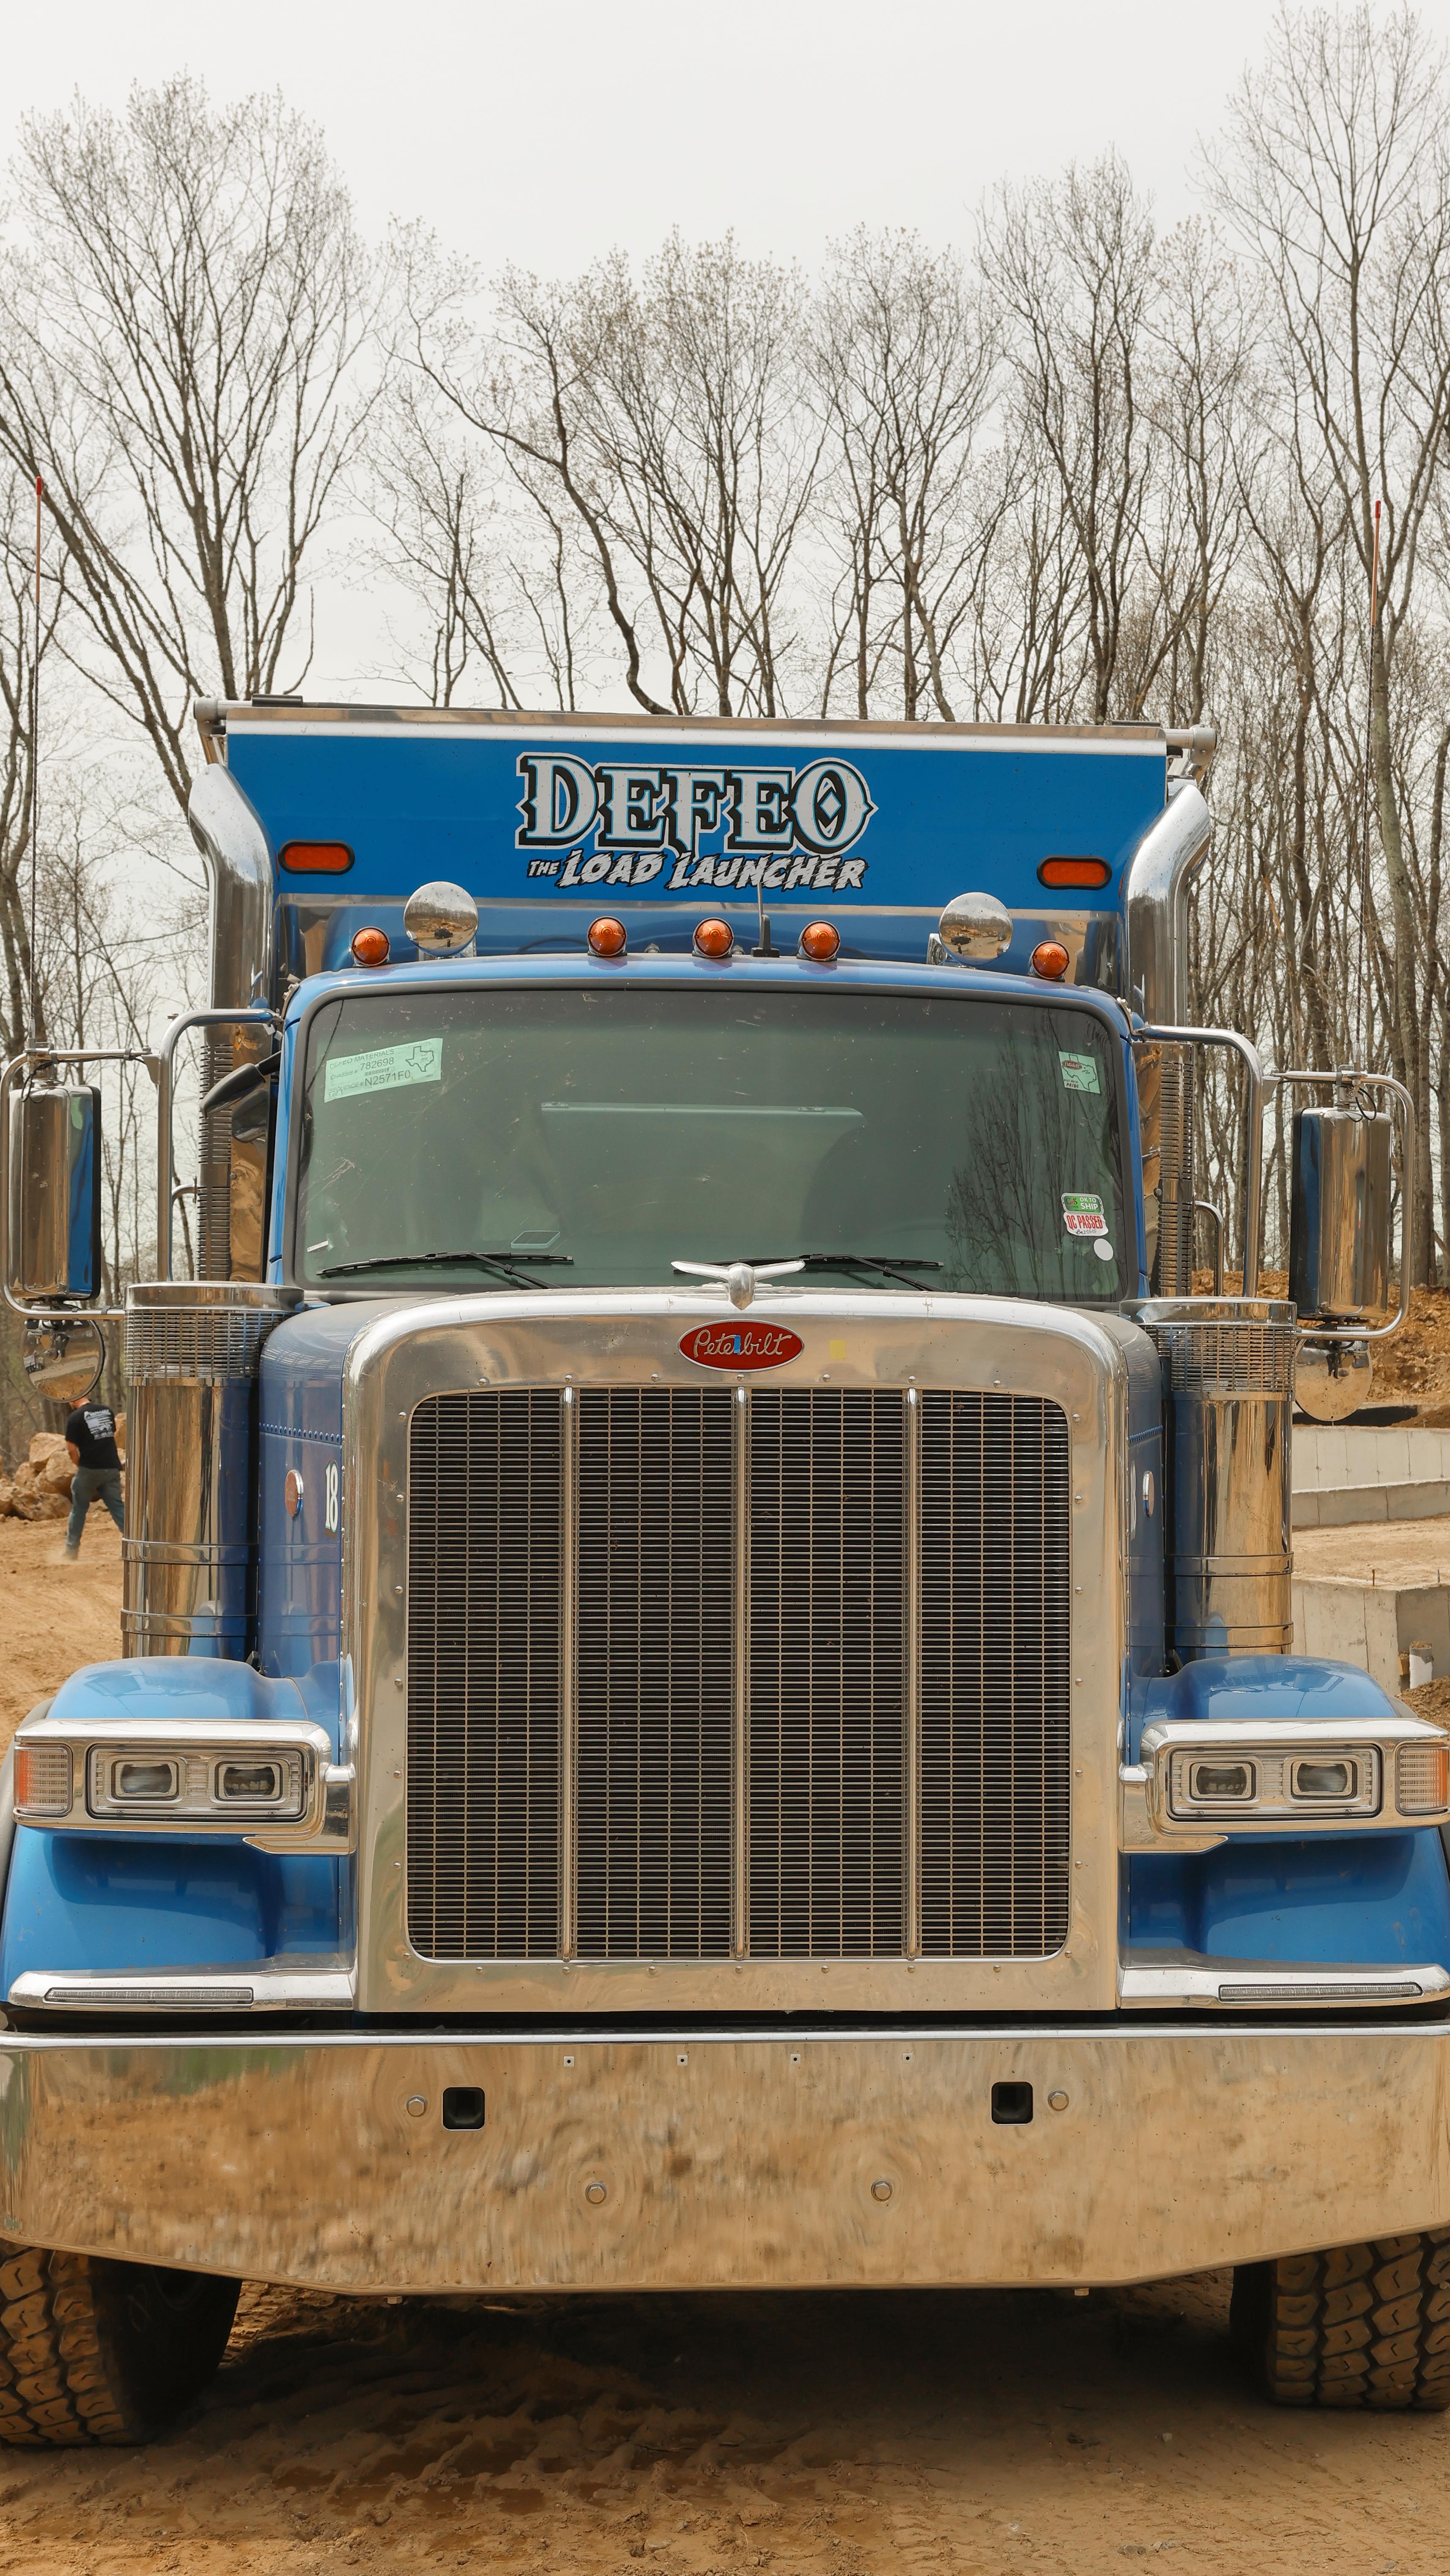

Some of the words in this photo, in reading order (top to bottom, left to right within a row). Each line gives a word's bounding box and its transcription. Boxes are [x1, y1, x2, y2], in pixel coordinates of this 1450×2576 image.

[516, 752, 878, 855] DEFEO
[527, 859, 559, 877] THE
[555, 849, 665, 888] LOAD
[666, 851, 869, 891] LAUNCHER
[330, 1058, 352, 1069] DEFEO
[354, 1049, 395, 1062] MATERIALS
[330, 1070, 353, 1080] CHASSIS
[360, 1057, 394, 1071] 782698
[330, 1082, 359, 1093] SEQUENCE
[365, 1070, 410, 1087] N2571F0
[1066, 1215, 1077, 1230] QC
[1077, 1215, 1103, 1229] PASSED
[693, 1329, 792, 1358] Petebilt
[325, 1463, 338, 1532] 18
